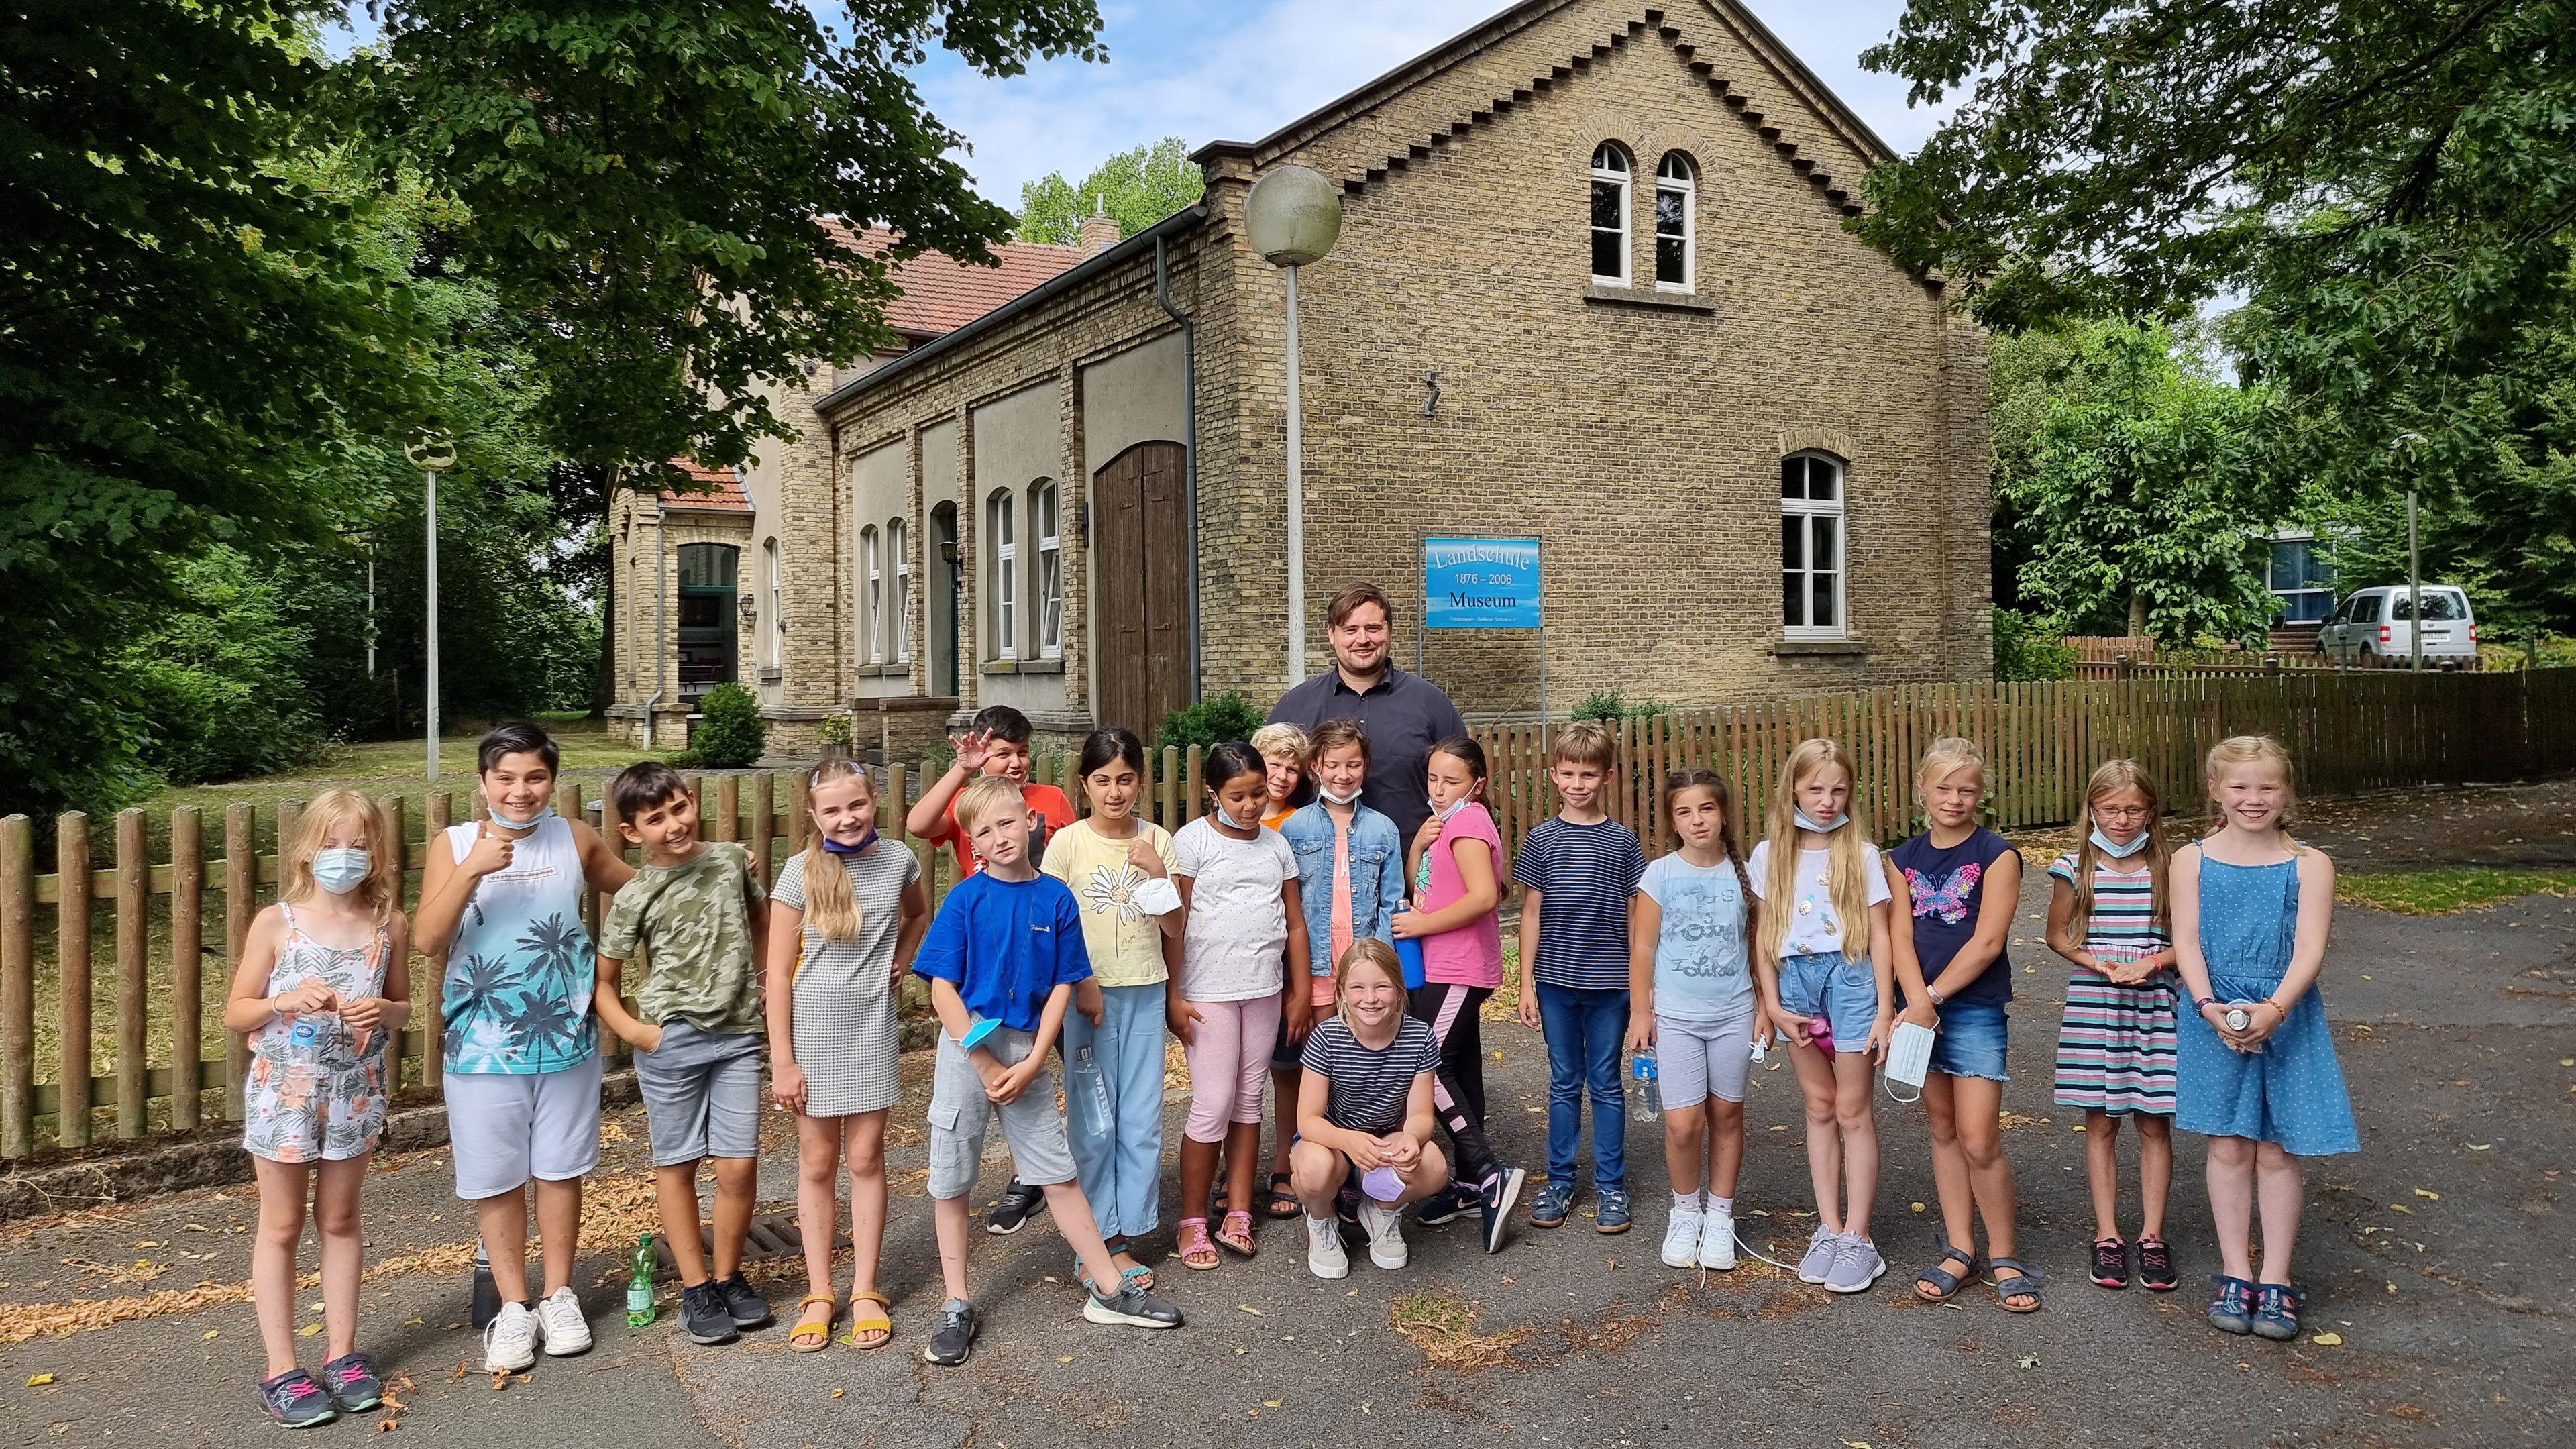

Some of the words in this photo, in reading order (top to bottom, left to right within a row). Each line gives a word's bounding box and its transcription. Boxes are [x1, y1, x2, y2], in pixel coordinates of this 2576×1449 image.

[1434, 544, 1529, 570] Landschule
[1454, 574, 1478, 584] 1876
[1489, 574, 1512, 584] 2006
[1450, 592, 1517, 608] Museum
[1095, 1073, 1109, 1117] WATER
